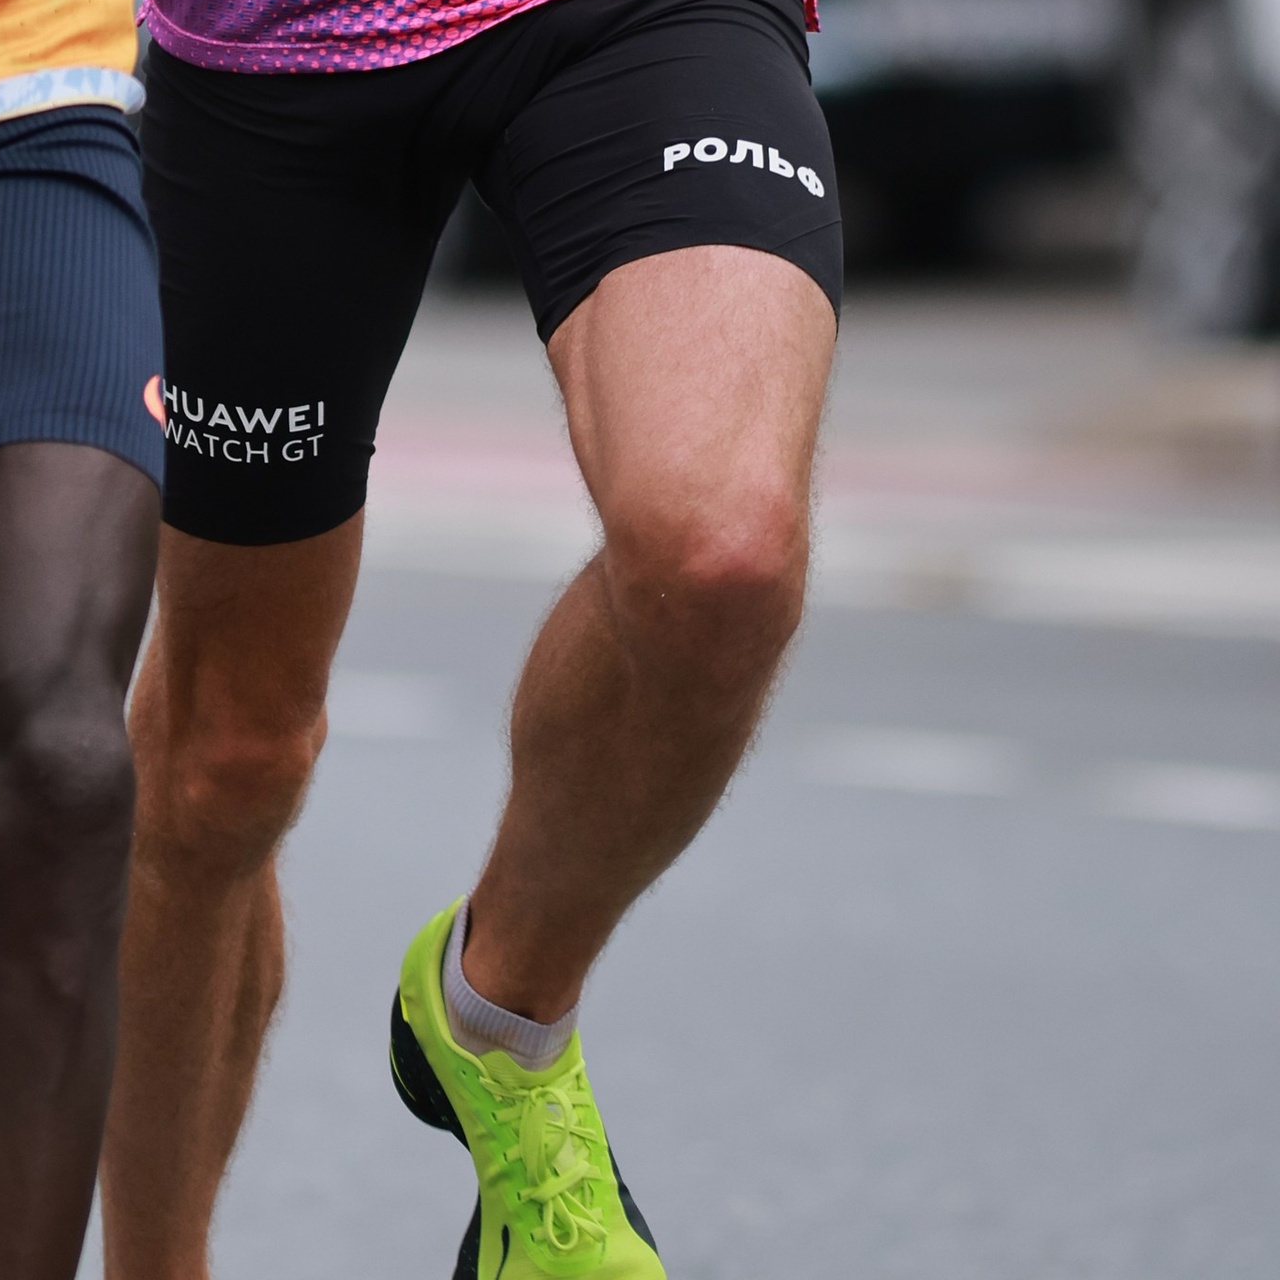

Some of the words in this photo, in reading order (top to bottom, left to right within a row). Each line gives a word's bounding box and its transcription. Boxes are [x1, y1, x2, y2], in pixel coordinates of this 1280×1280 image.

[663, 137, 825, 198] РОЛЬФ
[162, 378, 325, 434] HUAWEI
[165, 418, 270, 464] WATCH
[281, 433, 324, 462] GT
